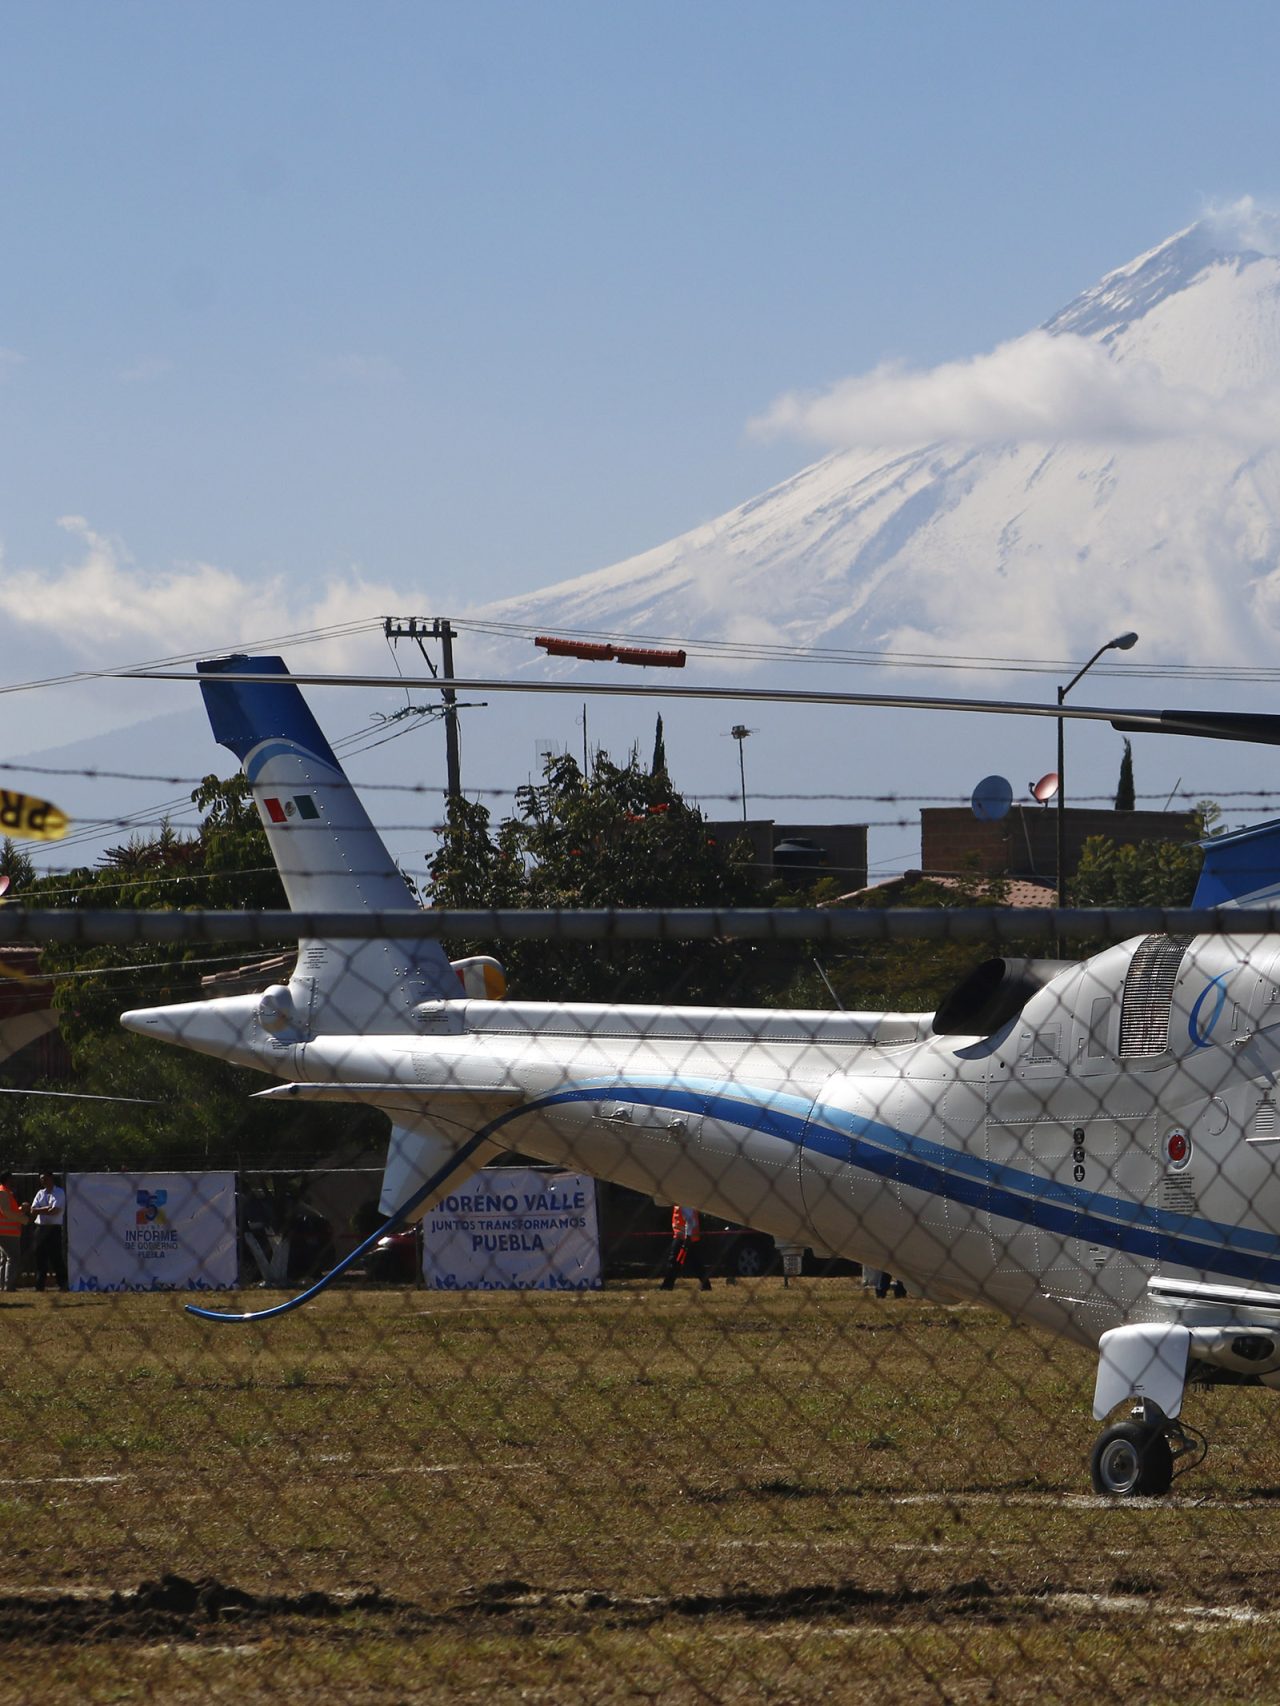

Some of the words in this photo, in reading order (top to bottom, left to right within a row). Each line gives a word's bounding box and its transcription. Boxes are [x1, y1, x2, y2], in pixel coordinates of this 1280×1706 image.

[524, 1192, 585, 1211] VALLE
[431, 1219, 475, 1233] JUNTOS
[478, 1217, 586, 1230] TRANSFORMAMOS
[125, 1230, 177, 1242] INFORME
[472, 1234, 544, 1252] PUEBLA
